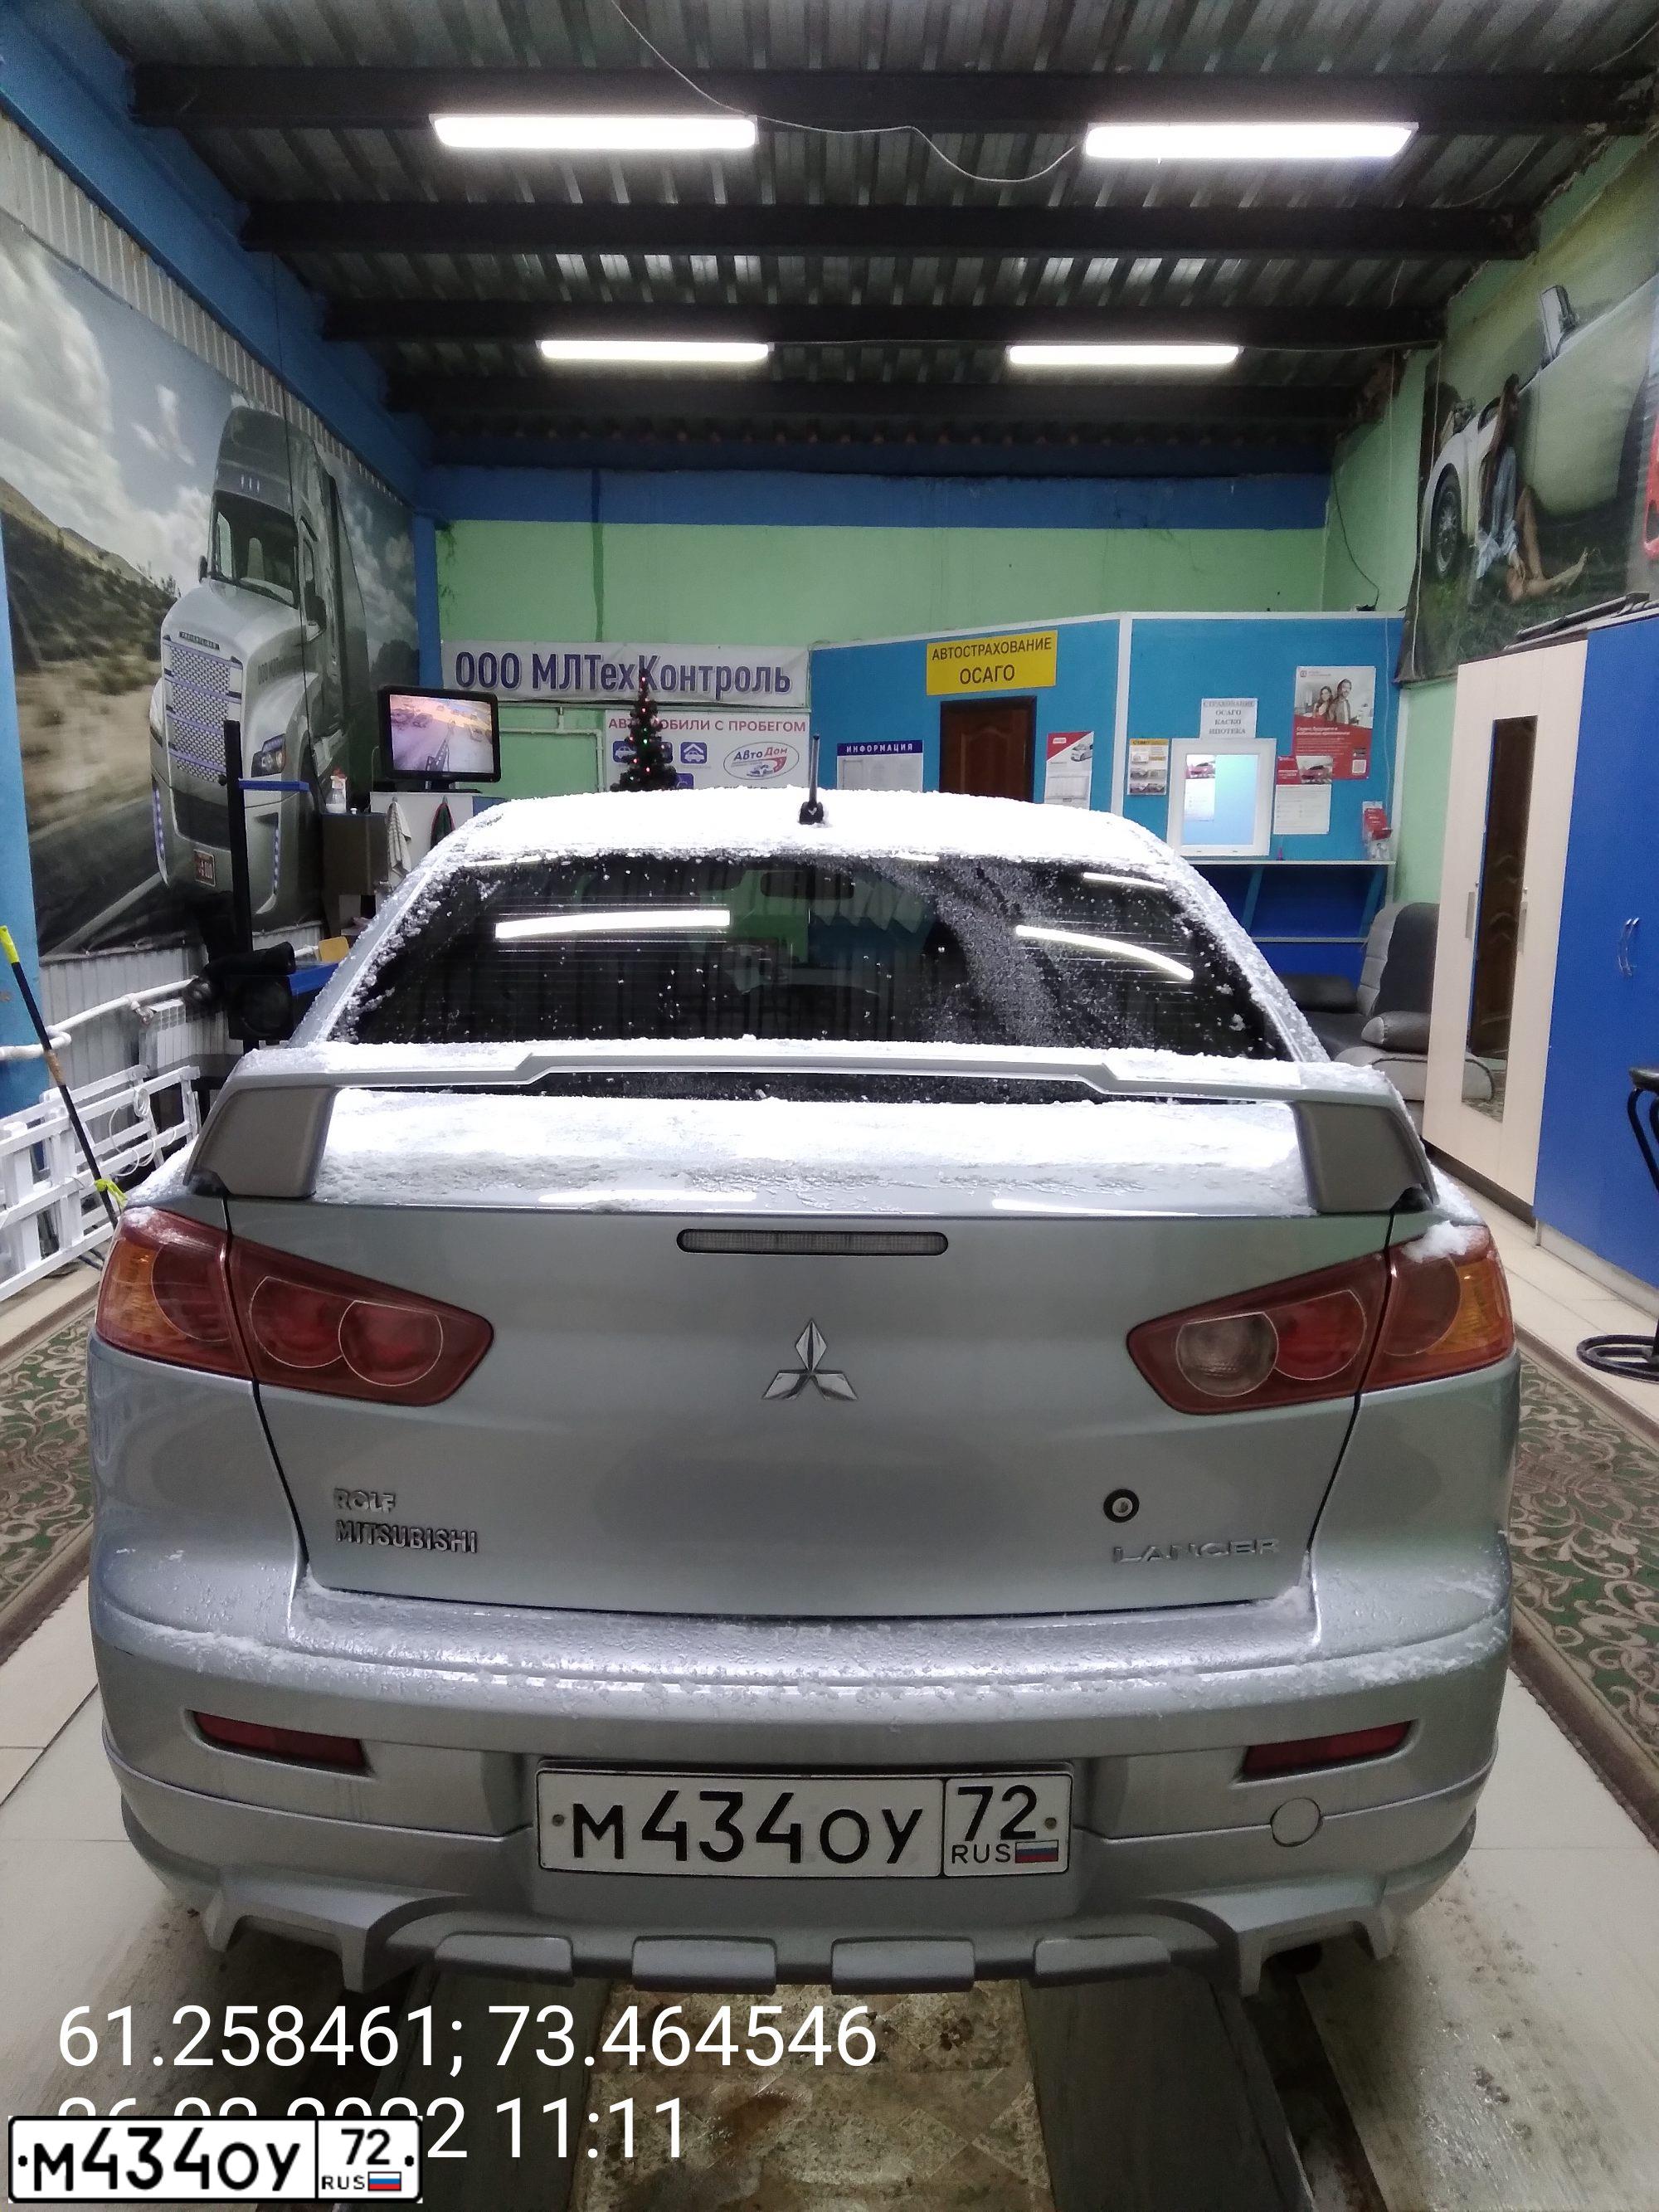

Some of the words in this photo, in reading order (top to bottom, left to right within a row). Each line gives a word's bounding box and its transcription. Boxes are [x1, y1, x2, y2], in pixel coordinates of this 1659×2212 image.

[932, 636, 1052, 660] АВТОСТРАХОВАНИЕ
[455, 651, 520, 689] ООО
[532, 653, 791, 700] МЛТехКонтроль
[960, 664, 1015, 685] ОСАГО
[608, 718, 710, 731] АВТОБИЛИ
[714, 720, 723, 731] С
[728, 720, 806, 732] ПРОБЕГОМ
[846, 743, 913, 753] ИНФОРМАЦИЯ
[334, 1488, 396, 1513] ROLF
[335, 1519, 478, 1553] MITSUBISHI
[1112, 1538, 1280, 1563] LANCER
[957, 1785, 1038, 1842] 72
[951, 1843, 1012, 1864] RUS
